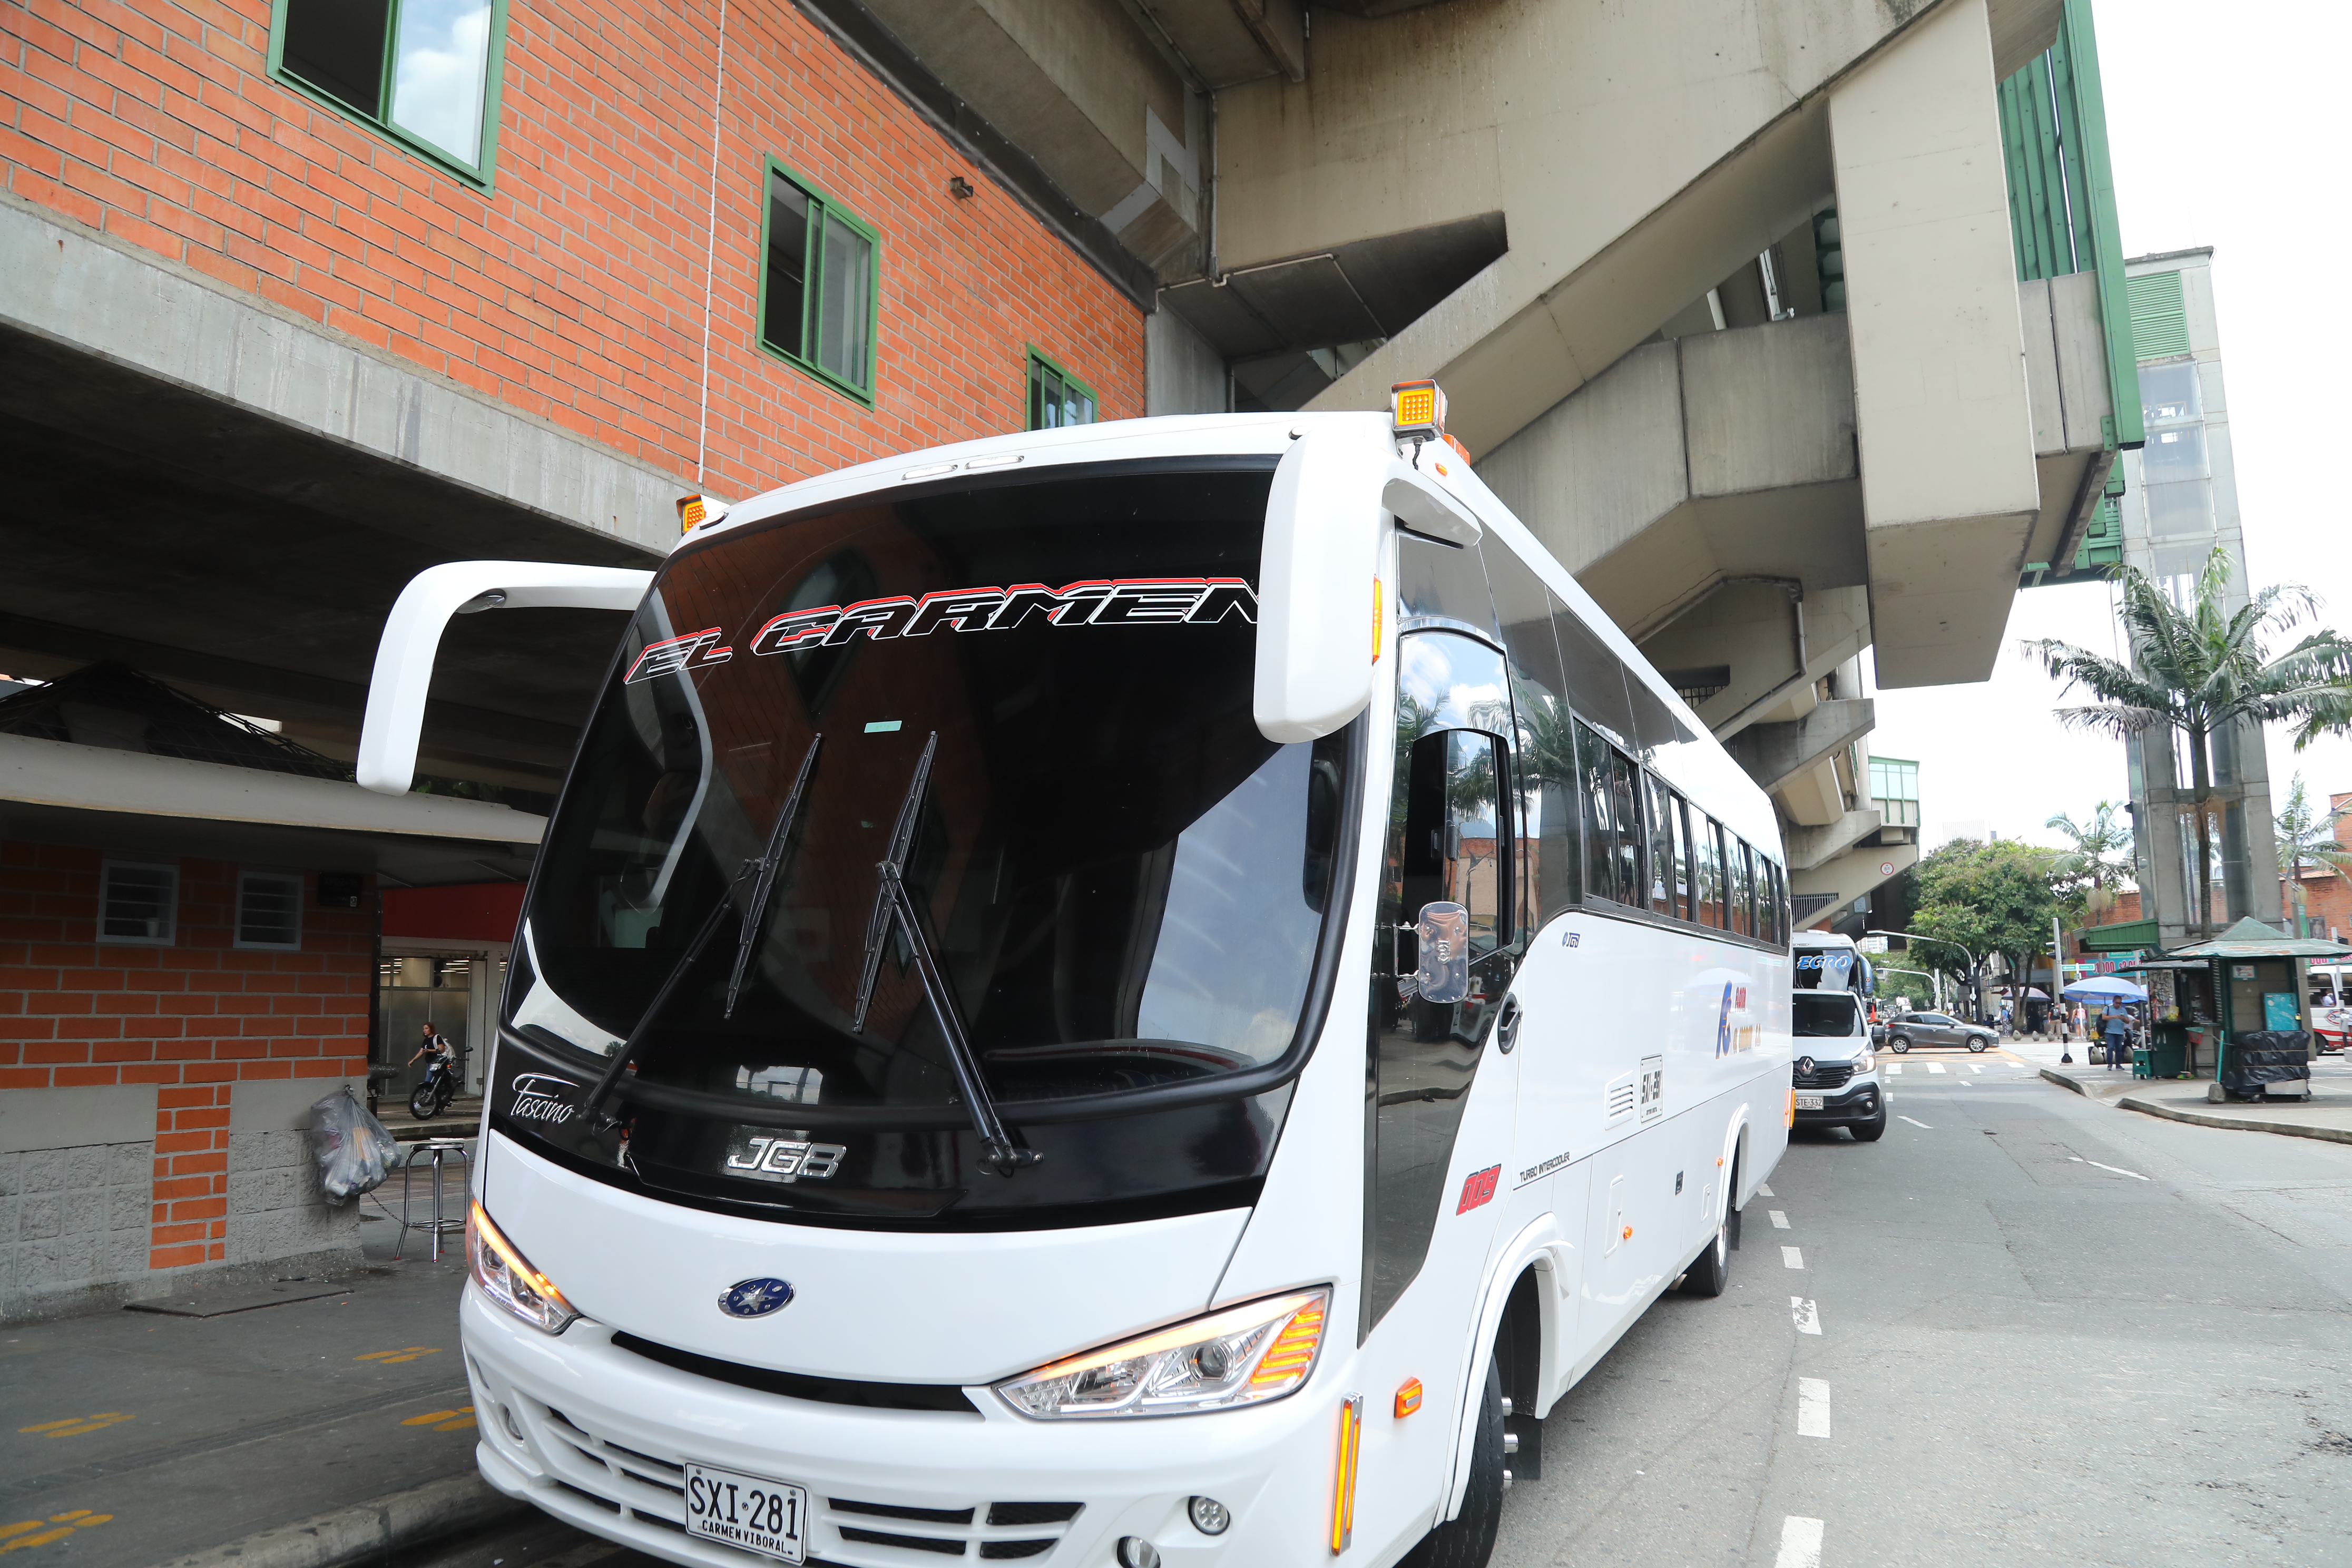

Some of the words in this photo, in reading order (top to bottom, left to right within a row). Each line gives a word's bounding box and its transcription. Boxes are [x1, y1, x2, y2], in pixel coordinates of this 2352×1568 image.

[623, 626, 733, 685] EL
[510, 1072, 580, 1124] Fascino
[727, 1136, 847, 1180] JGB
[1520, 1165, 1537, 1183] TURBO
[1538, 1151, 1570, 1175] INTERCOOLER
[1456, 1163, 1502, 1216] 009
[702, 1520, 741, 1541] CARMEN
[743, 1531, 787, 1554] VIBORAL
